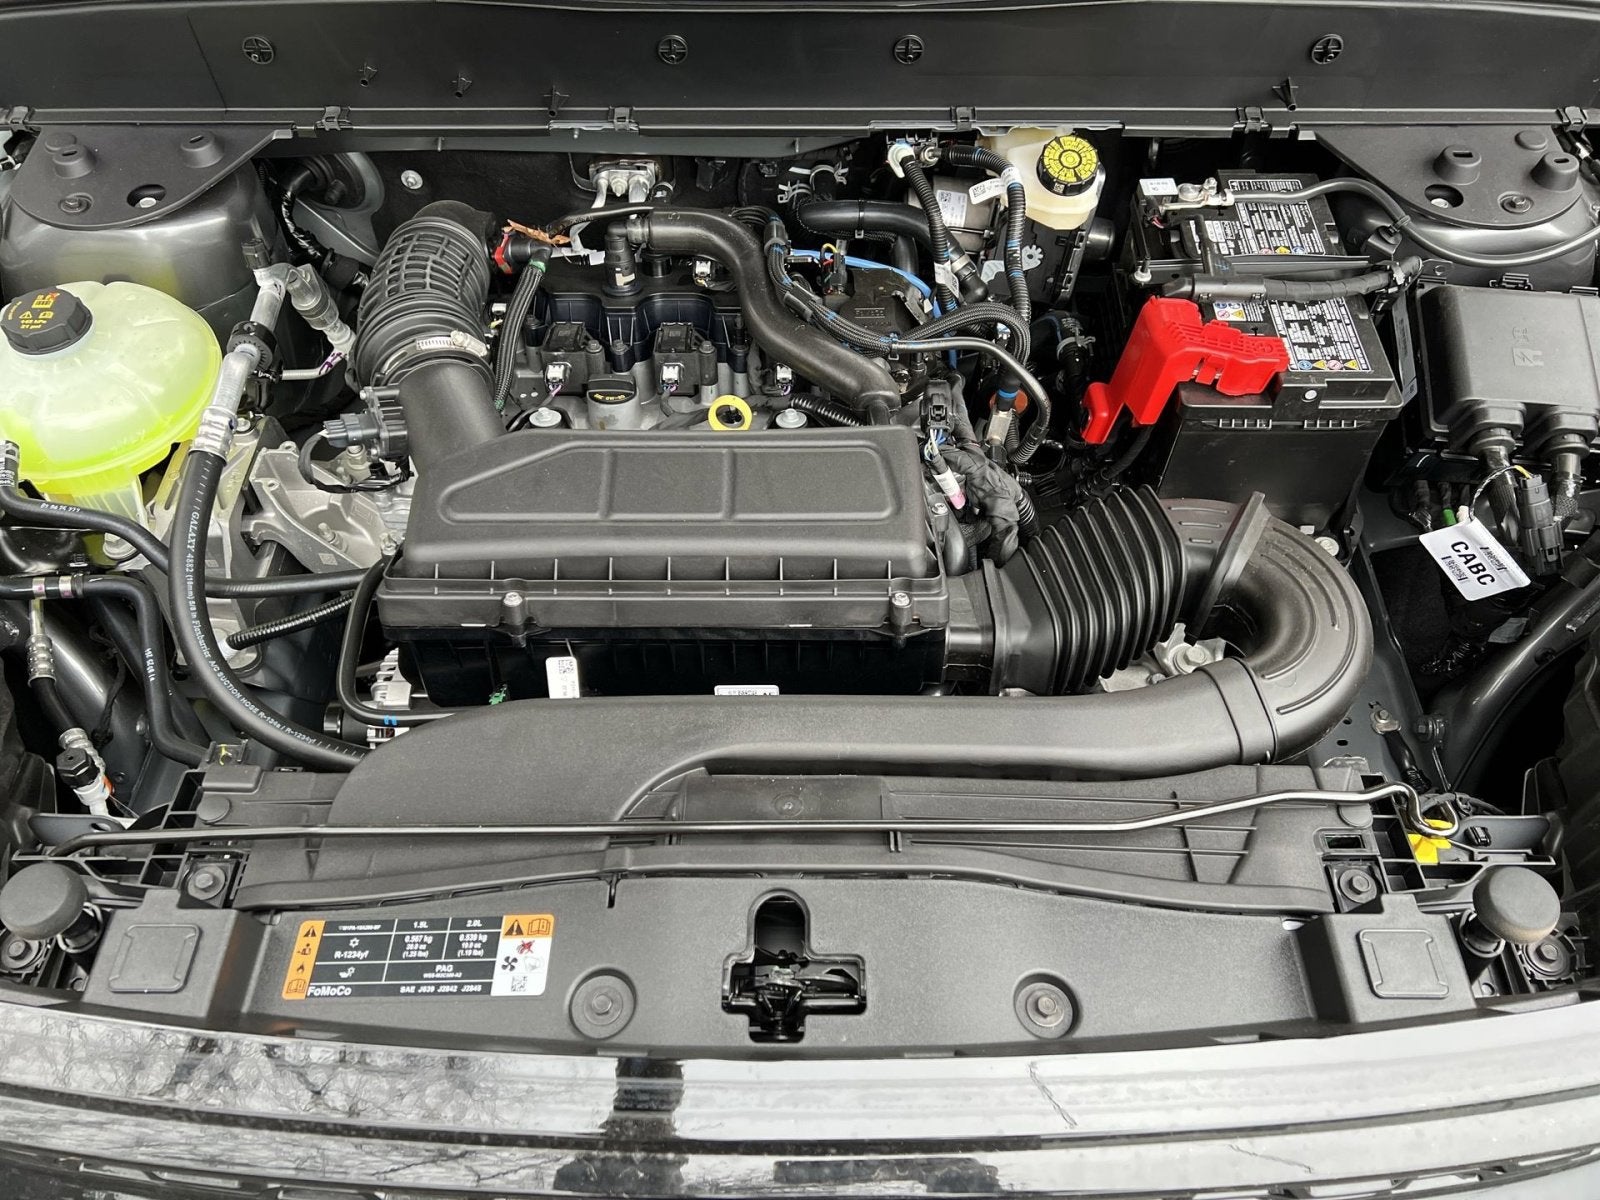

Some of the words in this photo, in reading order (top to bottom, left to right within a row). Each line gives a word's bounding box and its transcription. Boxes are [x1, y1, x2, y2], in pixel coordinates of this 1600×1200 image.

[186, 512, 200, 552] GALAXY
[186, 553, 194, 572] 4882
[1450, 541, 1495, 586] CABC
[192, 620, 211, 658] Flexbarrier
[217, 671, 242, 699] SUCTION
[240, 698, 260, 714] HOSE
[285, 727, 316, 744] R-1234yf
[423, 935, 433, 944] kg
[478, 933, 488, 943] kg
[334, 950, 369, 960] R-1234yf
[435, 964, 453, 972] PAG
[307, 986, 352, 997] FoMoCo
